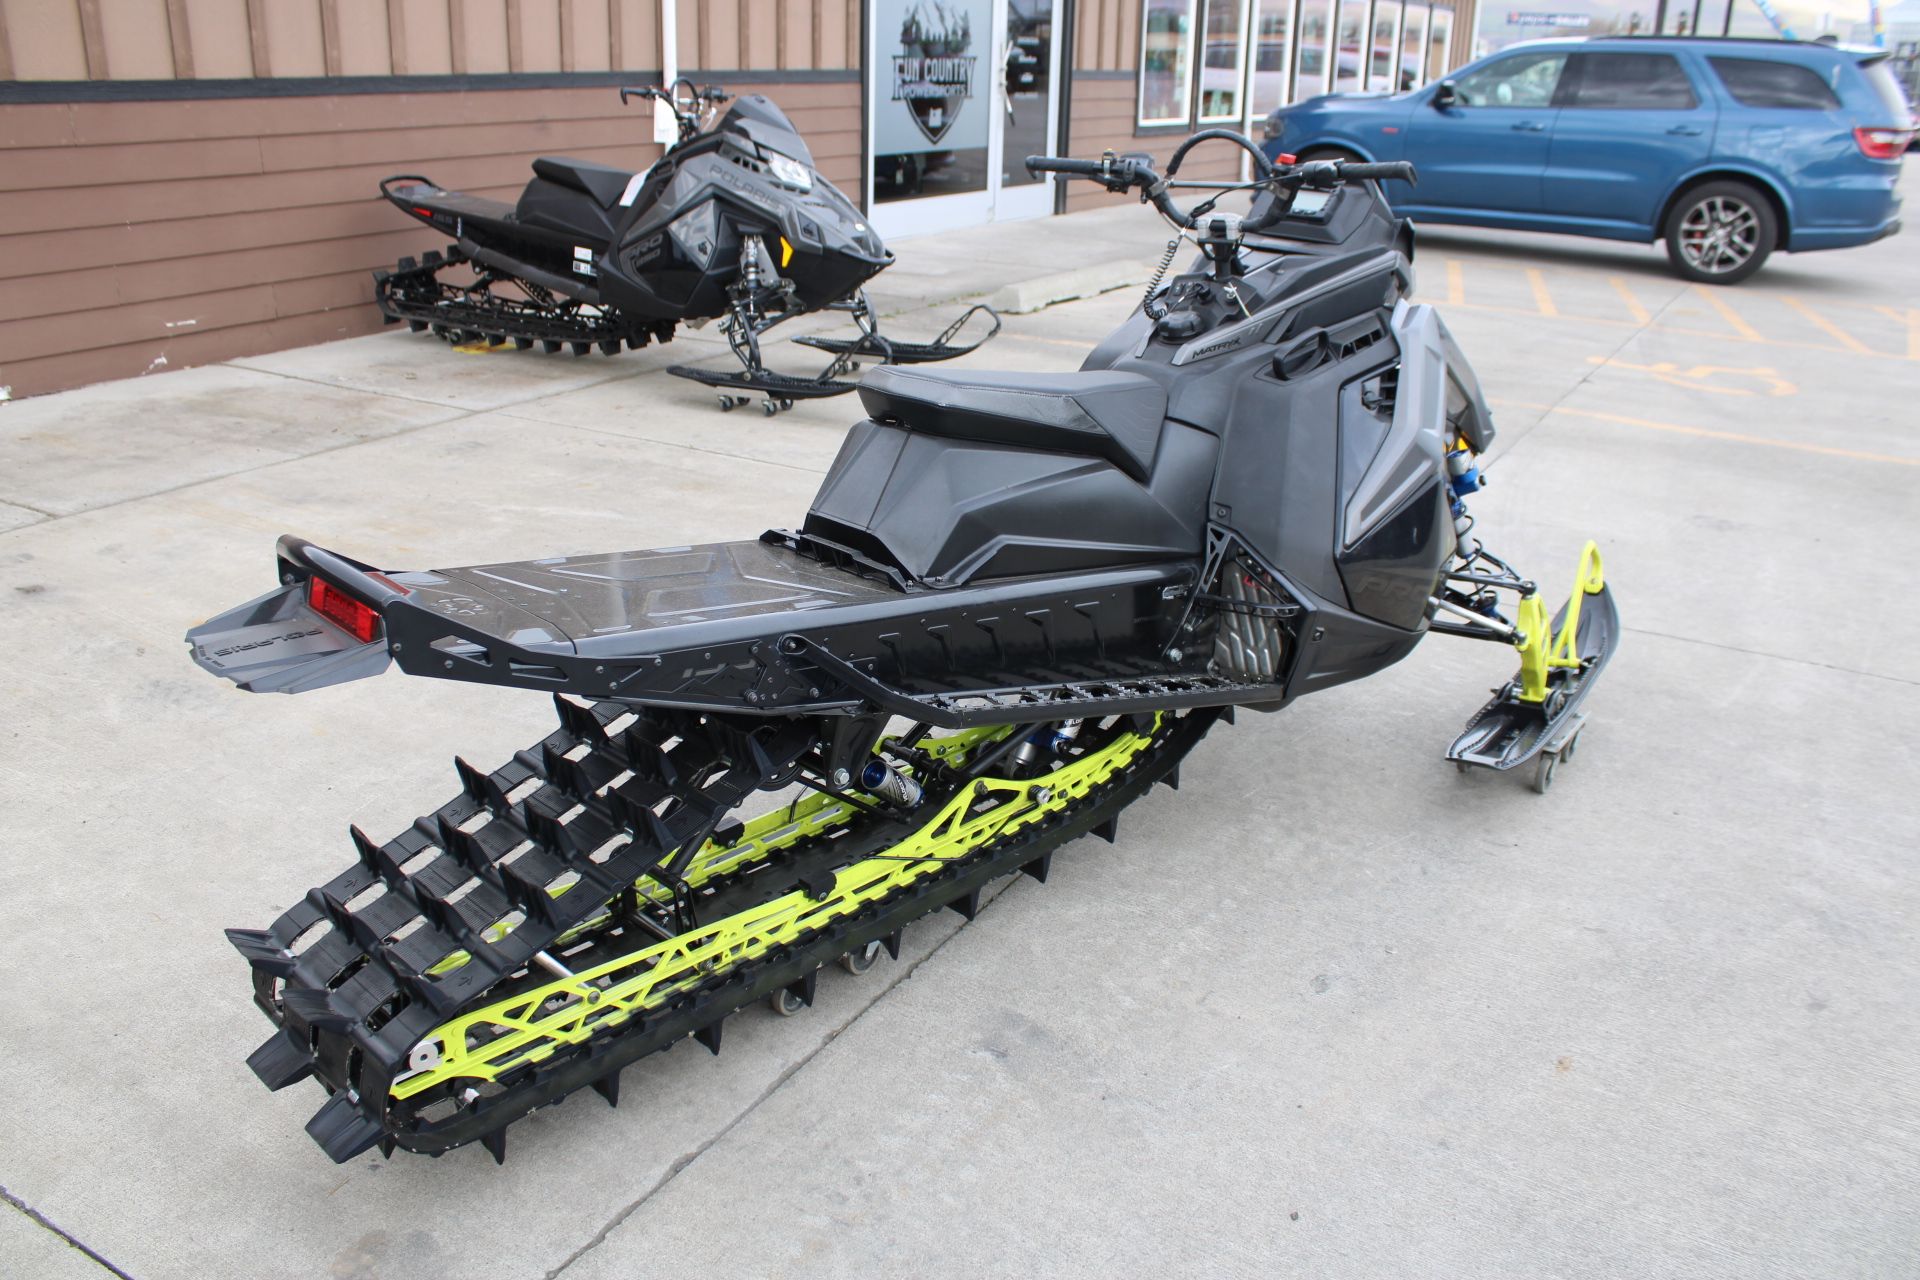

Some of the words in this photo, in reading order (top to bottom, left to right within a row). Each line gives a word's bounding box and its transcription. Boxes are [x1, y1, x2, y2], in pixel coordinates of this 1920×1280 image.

[892, 55, 921, 100] FUN
[924, 56, 978, 99] COUNTRY
[709, 163, 784, 211] POLARIS
[1192, 337, 1241, 360] MATRYX
[213, 628, 324, 658] POLARIS
